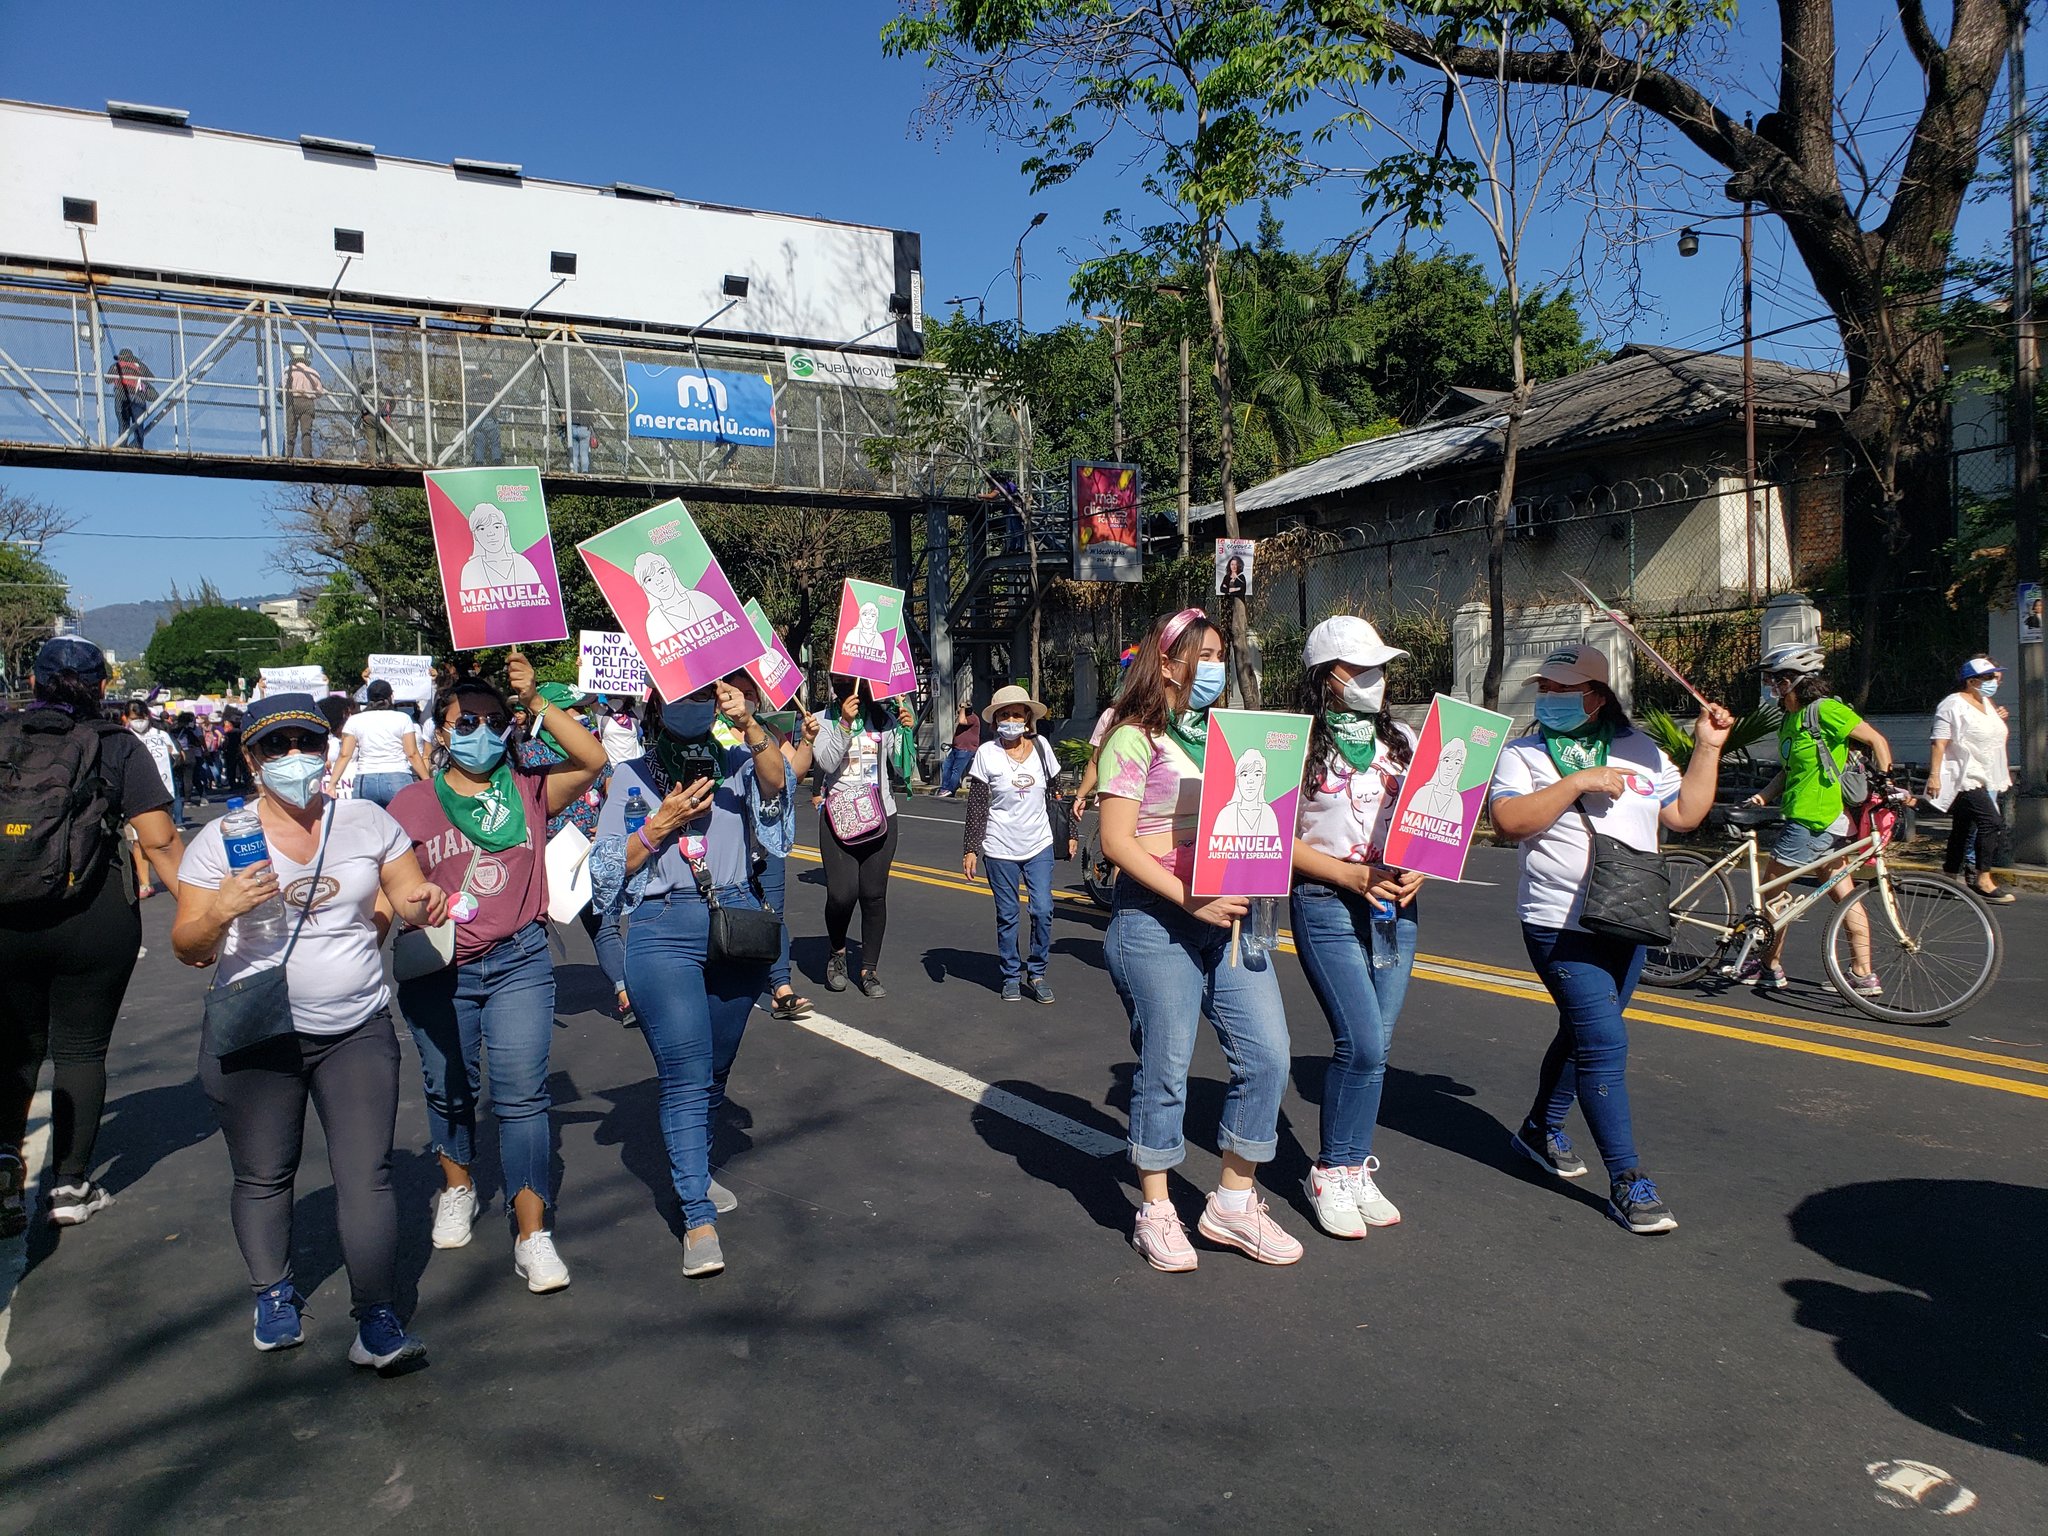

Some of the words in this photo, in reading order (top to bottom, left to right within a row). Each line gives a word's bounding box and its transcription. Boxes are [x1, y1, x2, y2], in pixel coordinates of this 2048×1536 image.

[459, 584, 550, 606] MANUELA
[462, 603, 499, 613] JUSTICIA
[507, 598, 551, 608] ESPERANZA
[603, 634, 621, 644] NO
[651, 610, 736, 660] MANUELA
[583, 645, 638, 657] MONTAJ
[660, 647, 693, 667] JUSTICIA
[697, 622, 740, 647] ESPERANZA
[842, 643, 887, 660] MANUELA
[595, 668, 647, 680] MUJERE
[764, 657, 789, 687] MANUELA
[892, 662, 910, 672] UELA
[589, 679, 645, 692] INOCENT
[6, 824, 28, 836] CAT
[1401, 811, 1462, 839] MANUELA
[1208, 836, 1283, 852] MANUELA
[1399, 825, 1424, 837] JUSTICIA
[1428, 831, 1460, 847] ESPERANZA
[233, 840, 266, 855] CRISTA
[426, 826, 534, 870] HARD
